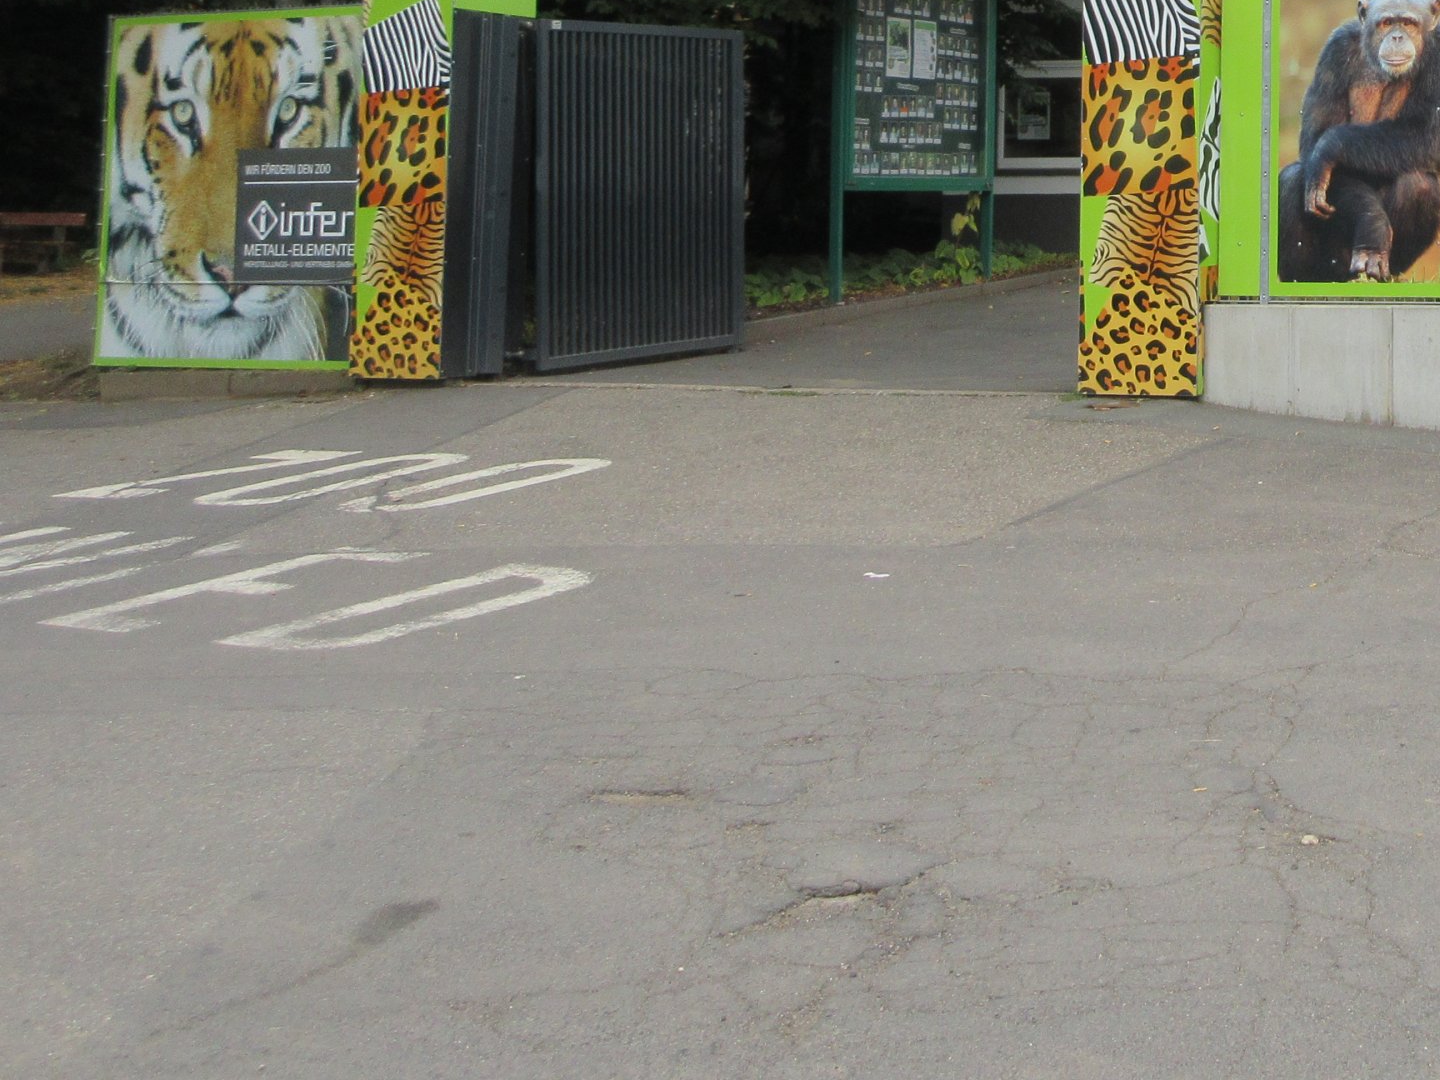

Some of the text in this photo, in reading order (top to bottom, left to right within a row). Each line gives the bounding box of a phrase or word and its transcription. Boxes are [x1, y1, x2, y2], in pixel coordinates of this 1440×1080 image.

[245, 163, 332, 176] WIR FÖRDERN DEN ZOO
[244, 243, 355, 257] METALL-ELEMENTE
